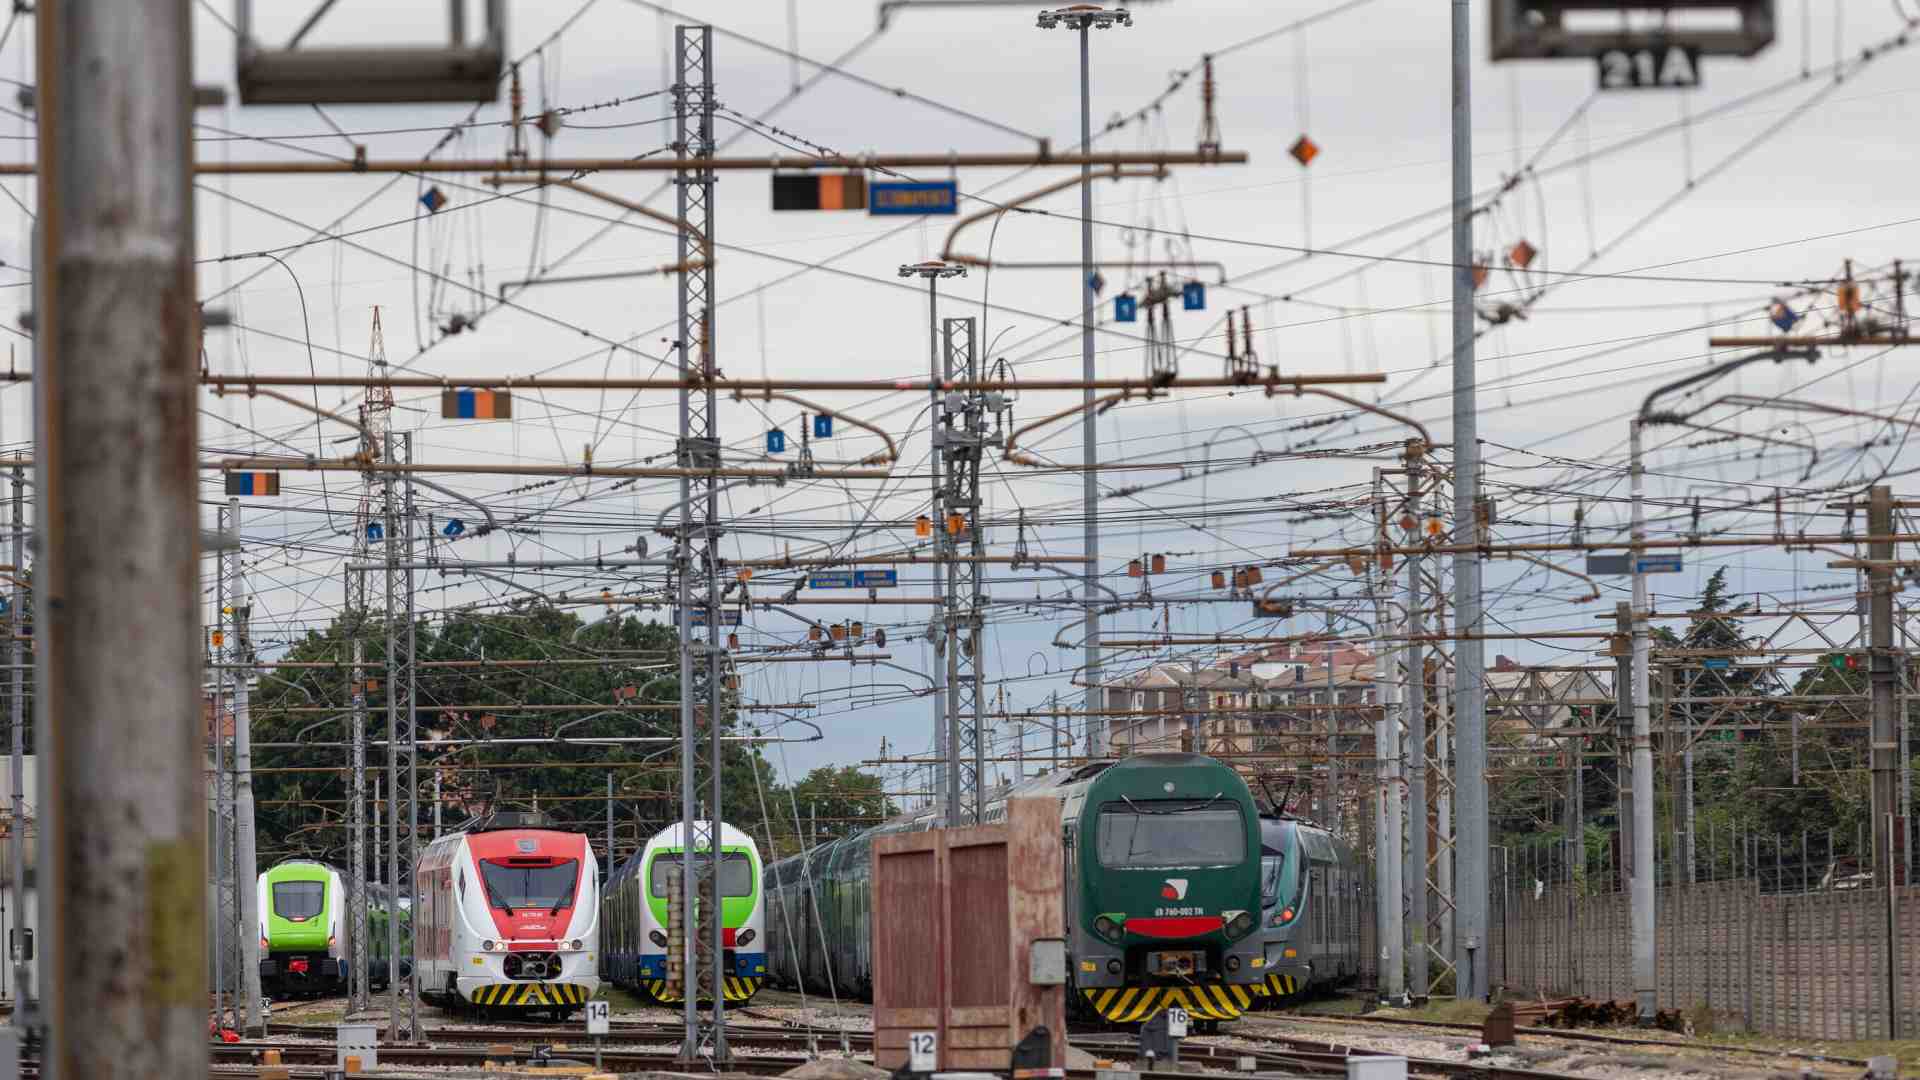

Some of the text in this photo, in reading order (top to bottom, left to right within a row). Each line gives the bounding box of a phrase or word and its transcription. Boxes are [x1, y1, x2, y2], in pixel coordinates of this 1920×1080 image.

[1601, 47, 1695, 84] 21A
[591, 1003, 608, 1020] 14
[1169, 1010, 1186, 1024] 16
[912, 1034, 934, 1054] 12
